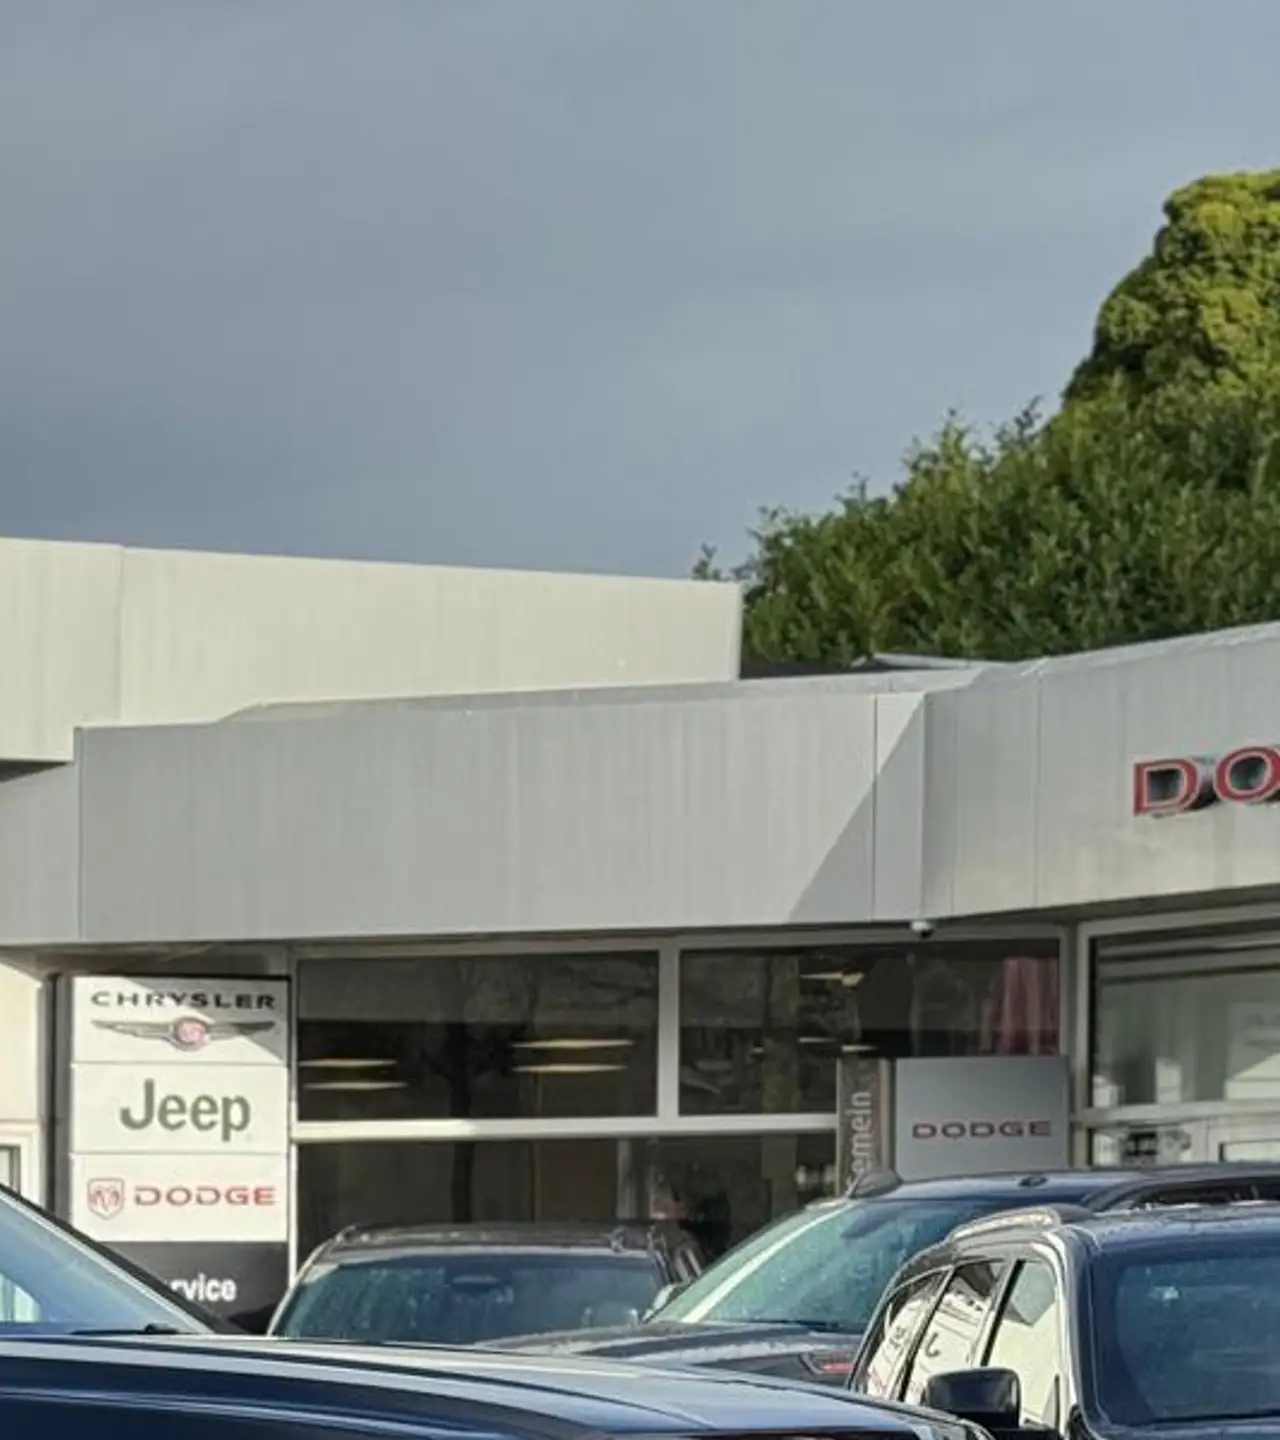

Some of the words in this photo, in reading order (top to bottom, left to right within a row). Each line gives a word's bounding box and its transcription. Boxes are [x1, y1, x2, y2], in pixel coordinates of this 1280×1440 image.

[90, 990, 276, 1010] CHRYSLER
[120, 1078, 252, 1142] Jeep
[912, 1120, 1053, 1140] DODGE
[133, 1186, 276, 1207] DODGE
[168, 1271, 238, 1302] rvice
